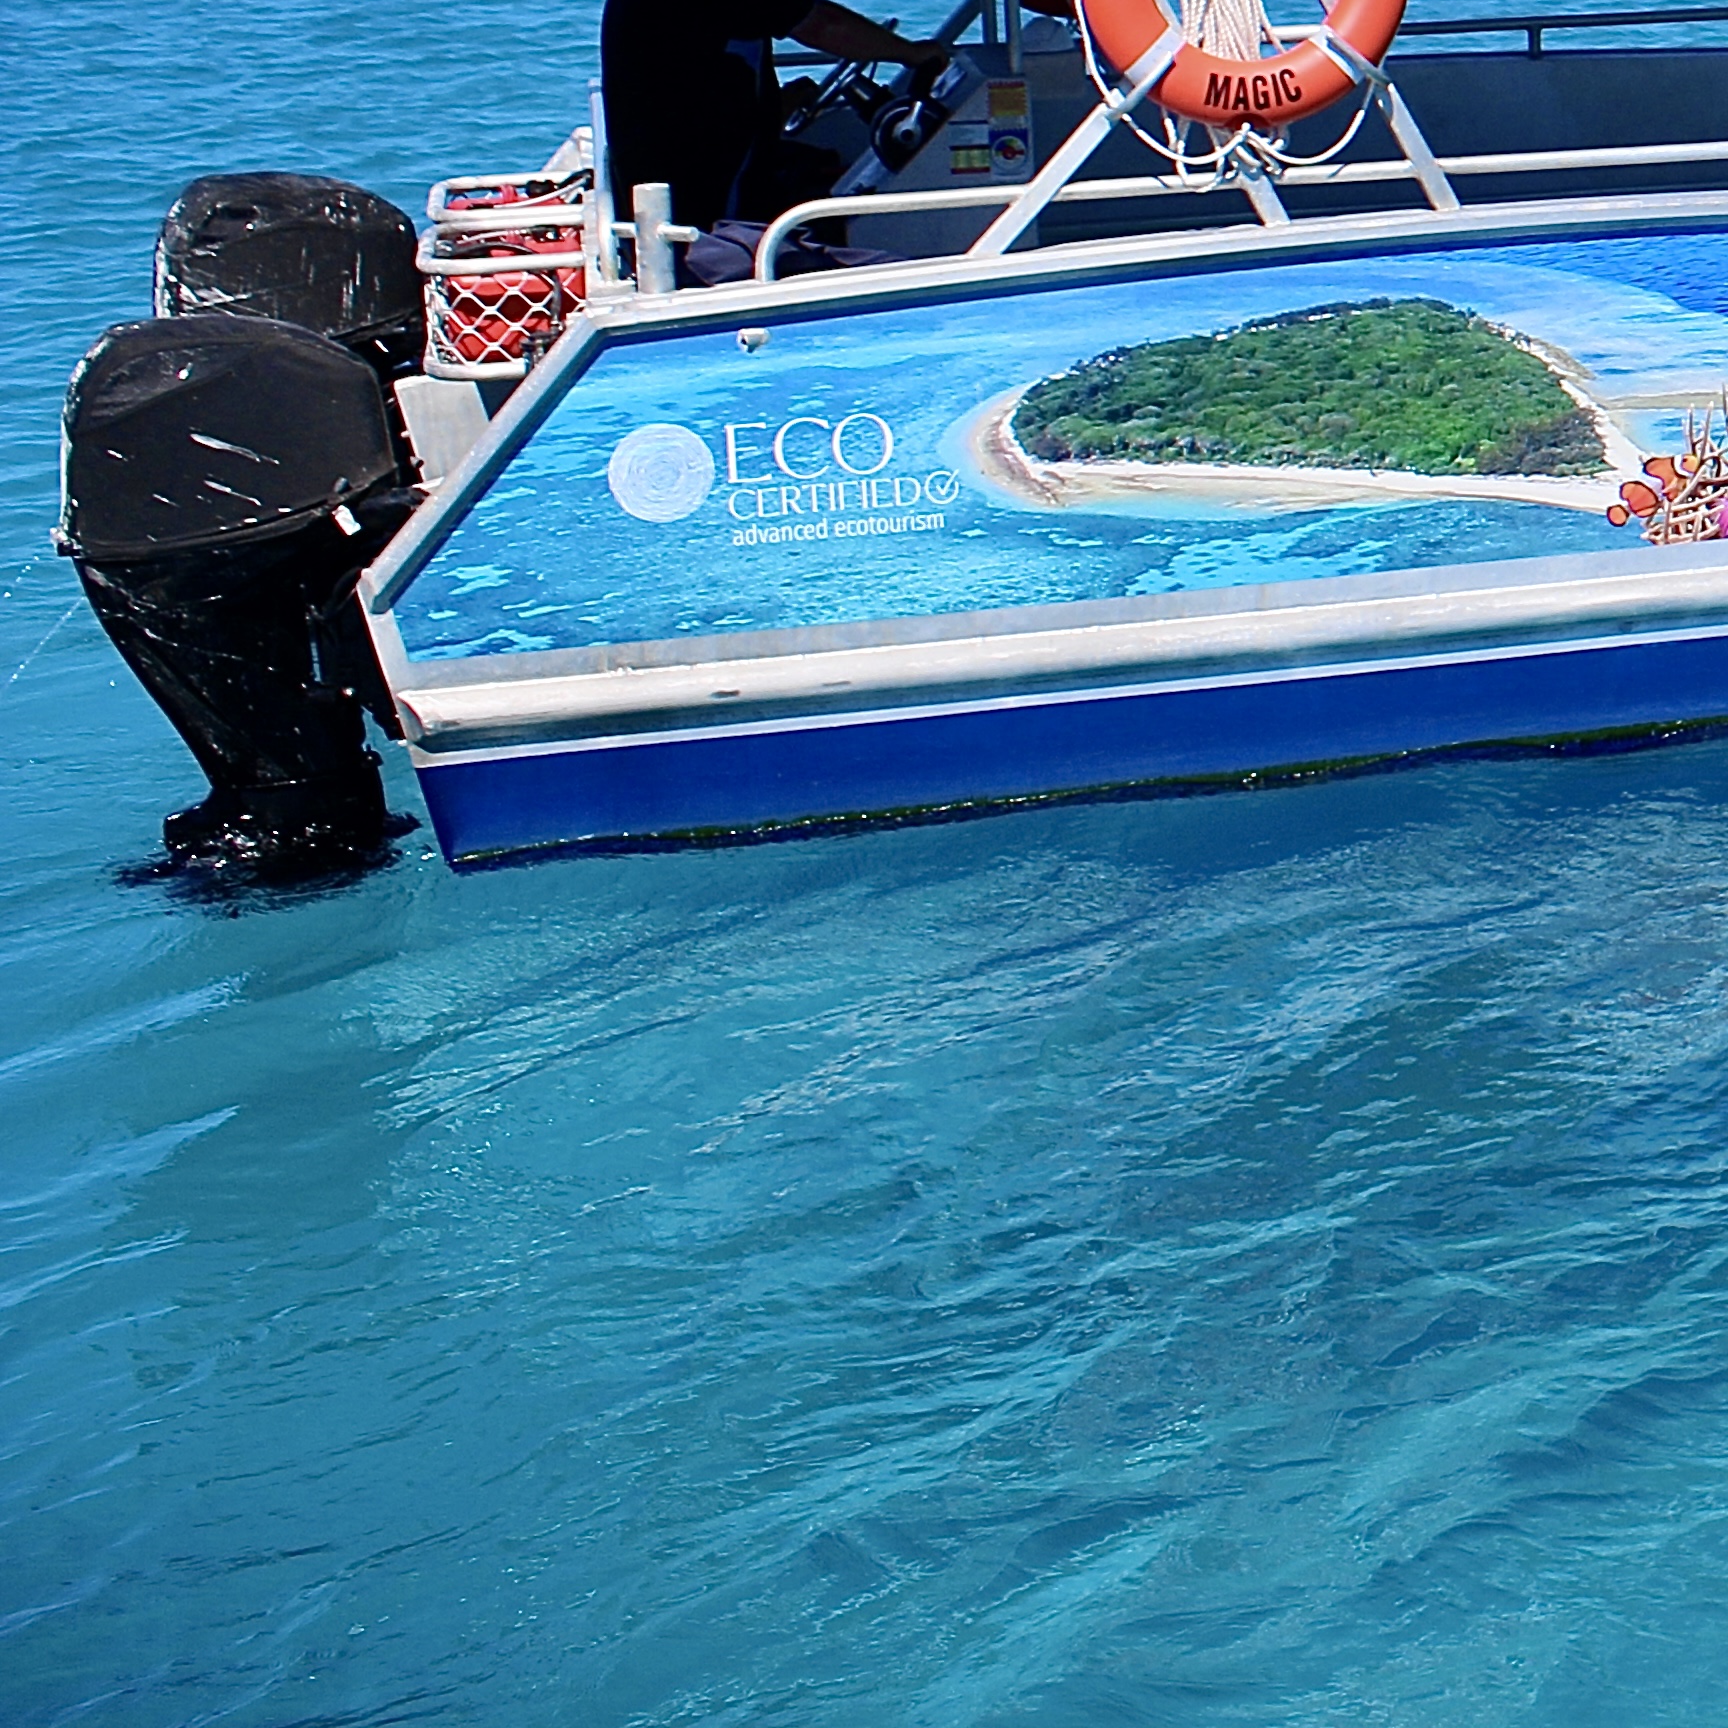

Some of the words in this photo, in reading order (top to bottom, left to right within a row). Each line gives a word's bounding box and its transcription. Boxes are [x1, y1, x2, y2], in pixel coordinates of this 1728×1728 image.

[1204, 69, 1302, 110] MAGIC
[724, 412, 895, 484] ECO
[728, 477, 922, 520] CERTIFIED
[732, 518, 828, 546] advanced
[834, 510, 945, 537] ecotourism
